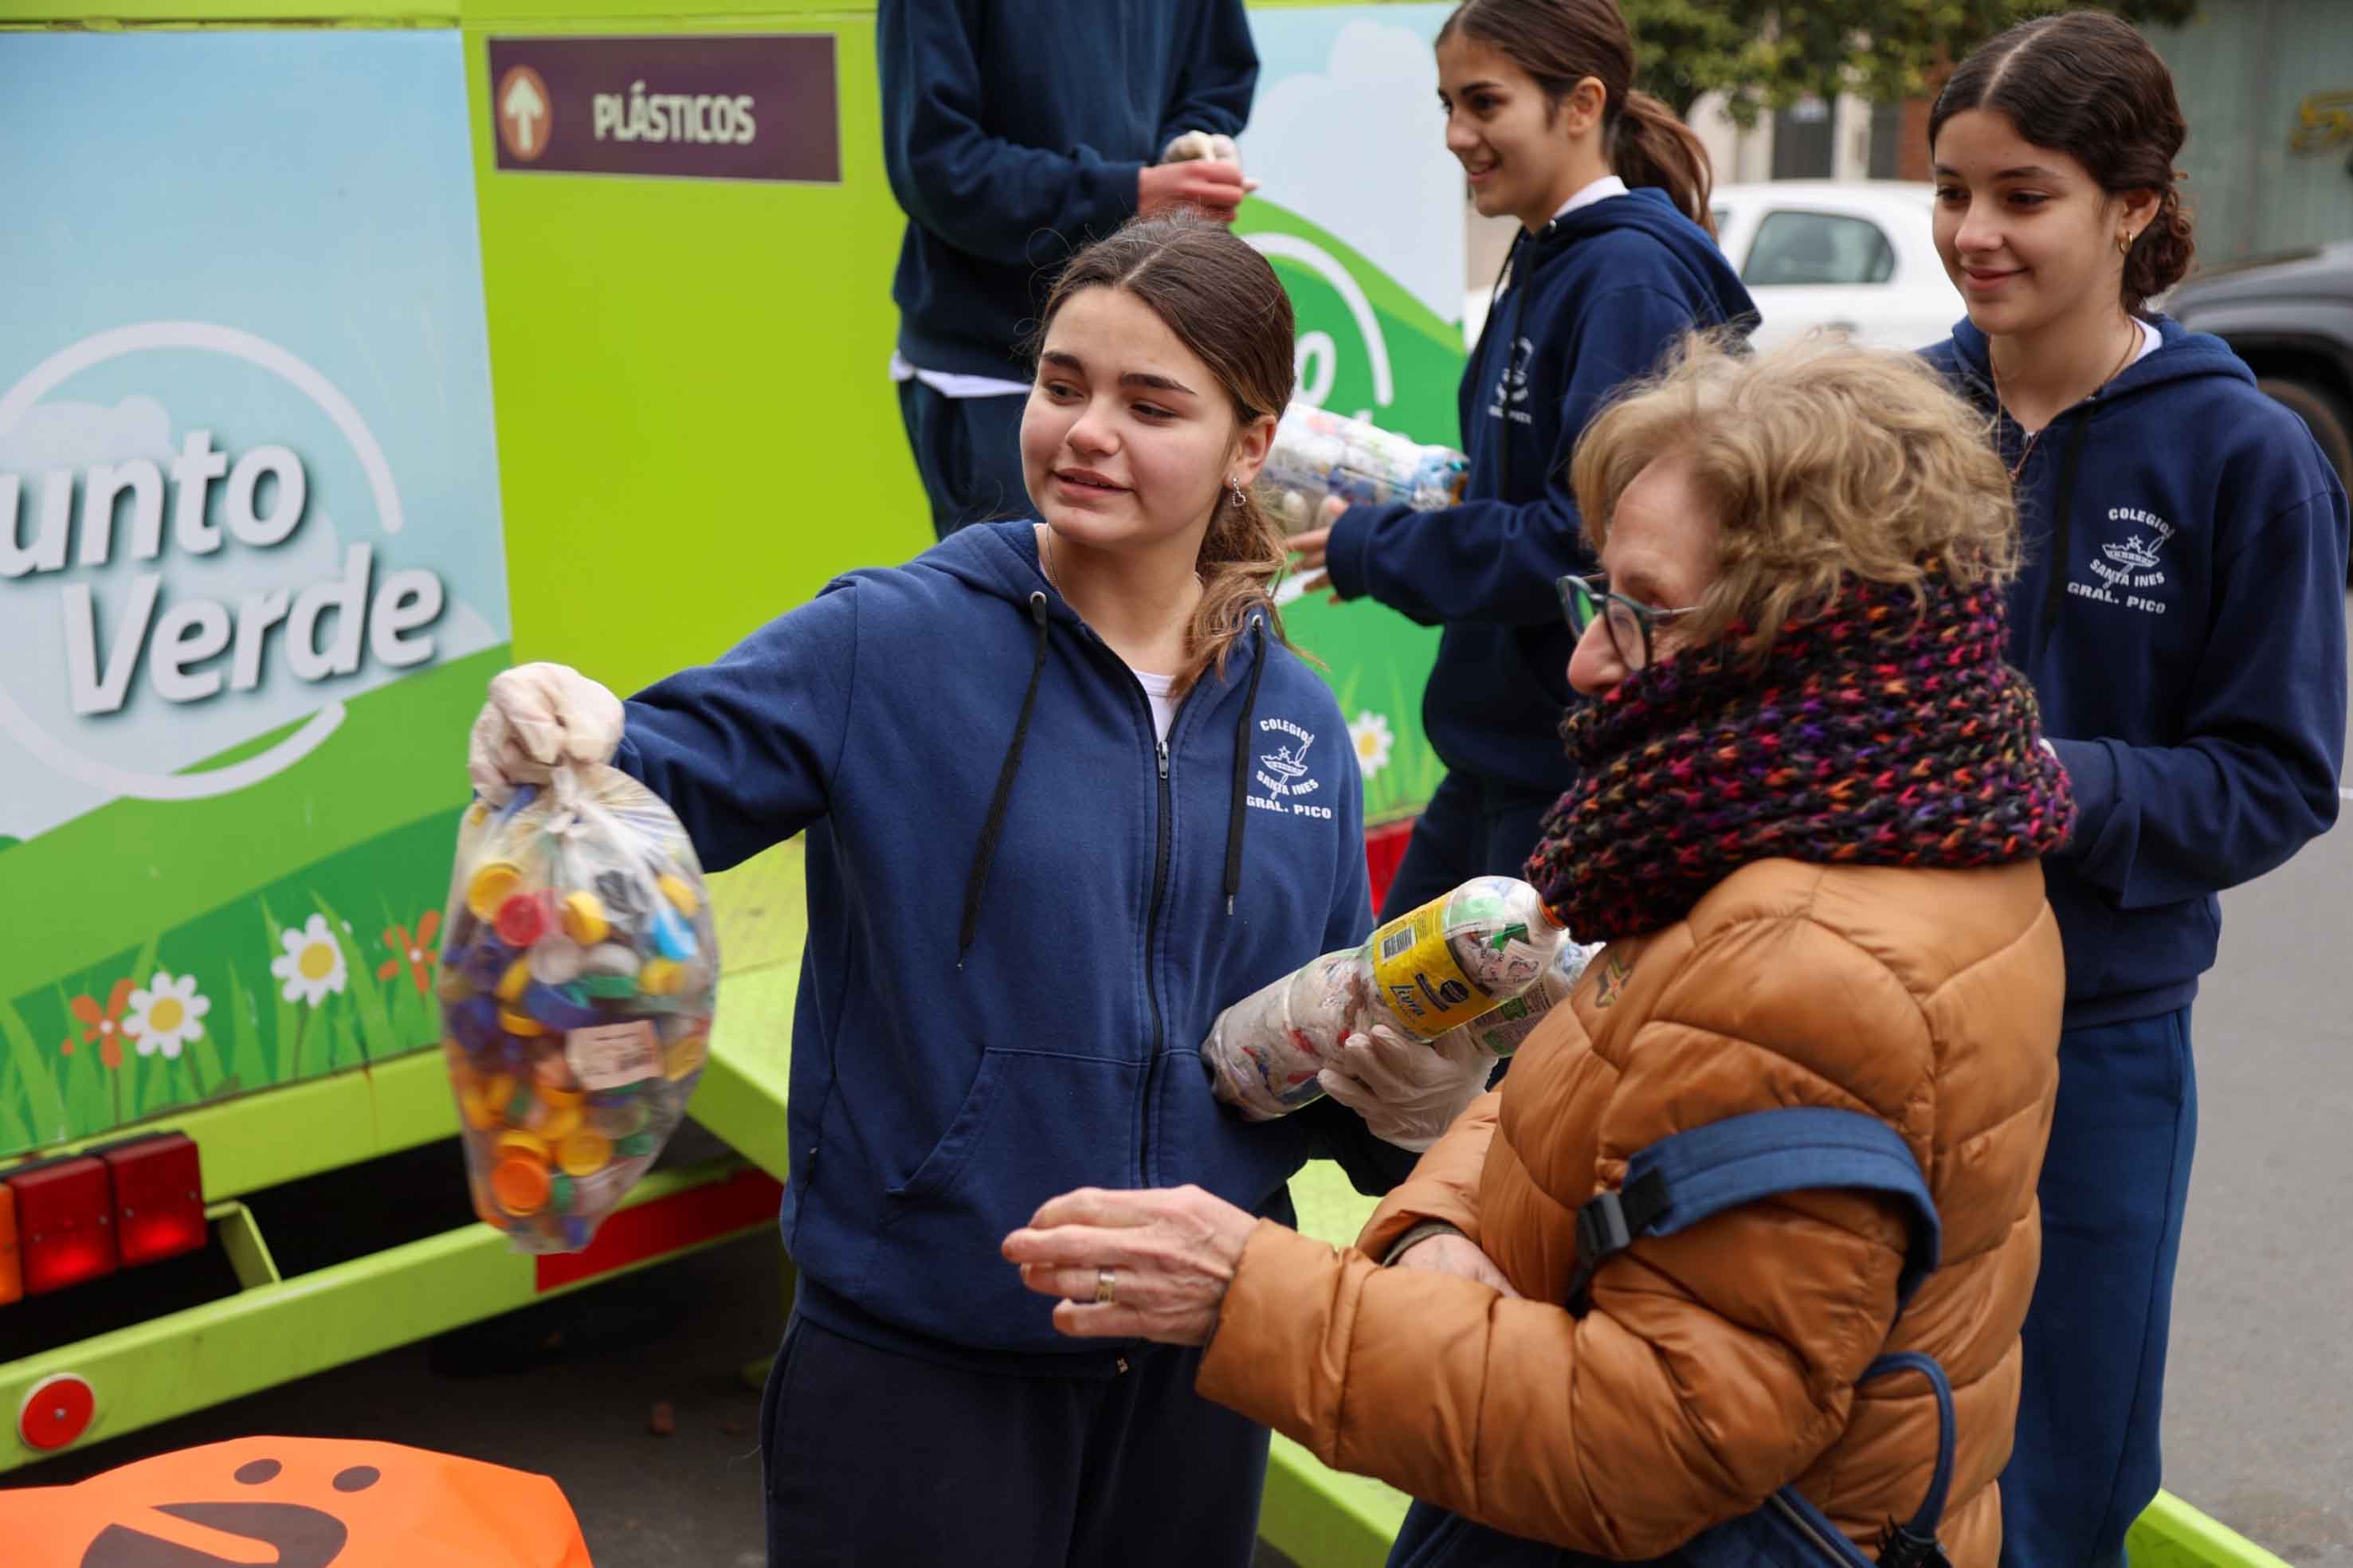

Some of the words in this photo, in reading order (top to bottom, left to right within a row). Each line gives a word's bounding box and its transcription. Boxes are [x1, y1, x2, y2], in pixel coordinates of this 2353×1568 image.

[594, 80, 756, 145] PLÁSTICOS
[2108, 507, 2171, 534] COLEGIO
[2089, 559, 2130, 586] SANTA
[2134, 571, 2166, 587] INES
[2066, 582, 2120, 604] GRAL.
[2126, 595, 2167, 614] PICO
[63, 542, 445, 715] Verde
[1260, 718, 1310, 742] COLEGIO
[1255, 770, 1290, 795] SANTA
[1292, 778, 1320, 795] INES
[1246, 795, 1289, 813] GRAL.
[1293, 804, 1332, 820] PICO
